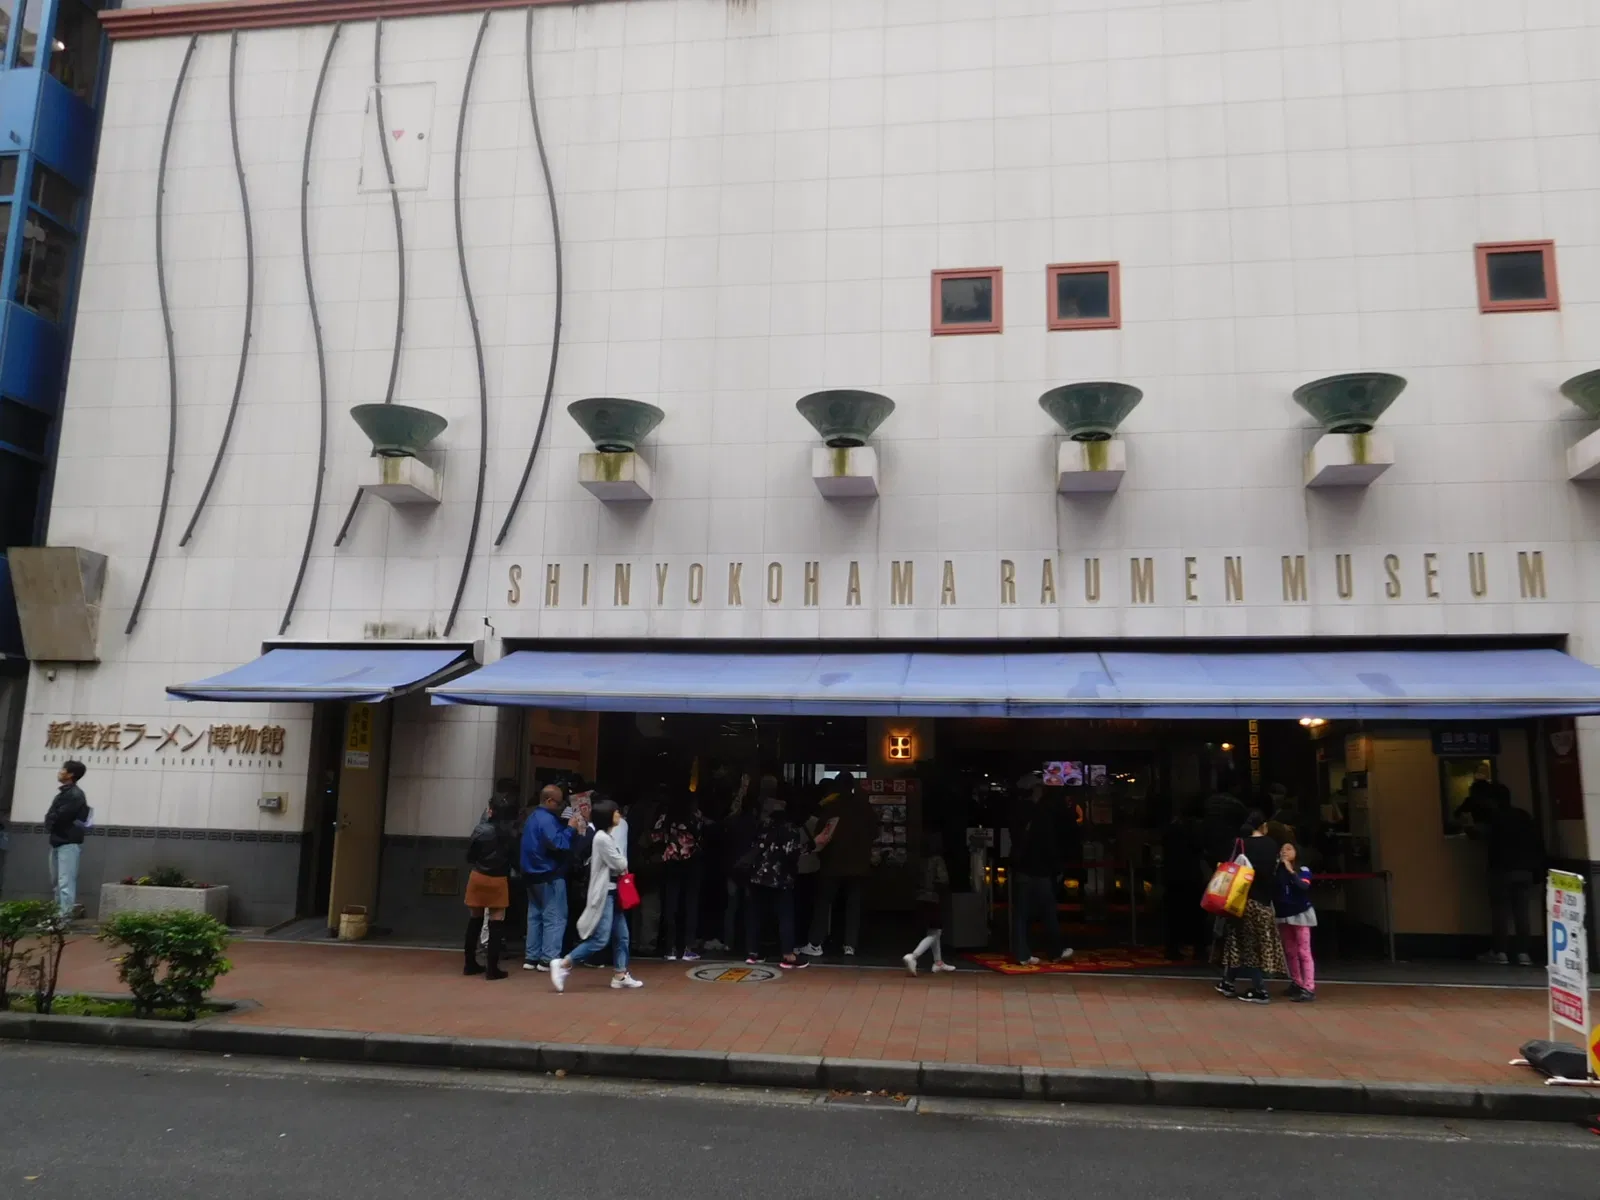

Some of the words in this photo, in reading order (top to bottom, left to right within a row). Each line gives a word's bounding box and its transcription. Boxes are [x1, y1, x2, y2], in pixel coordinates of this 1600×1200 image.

[507, 560, 956, 607] SHINYOKOHAMA
[1000, 556, 1244, 606] RAUMEN
[1281, 551, 1547, 602] MUSEUM
[44, 720, 286, 755] 新横浜ラーメン博物館
[1552, 920, 1568, 965] P
